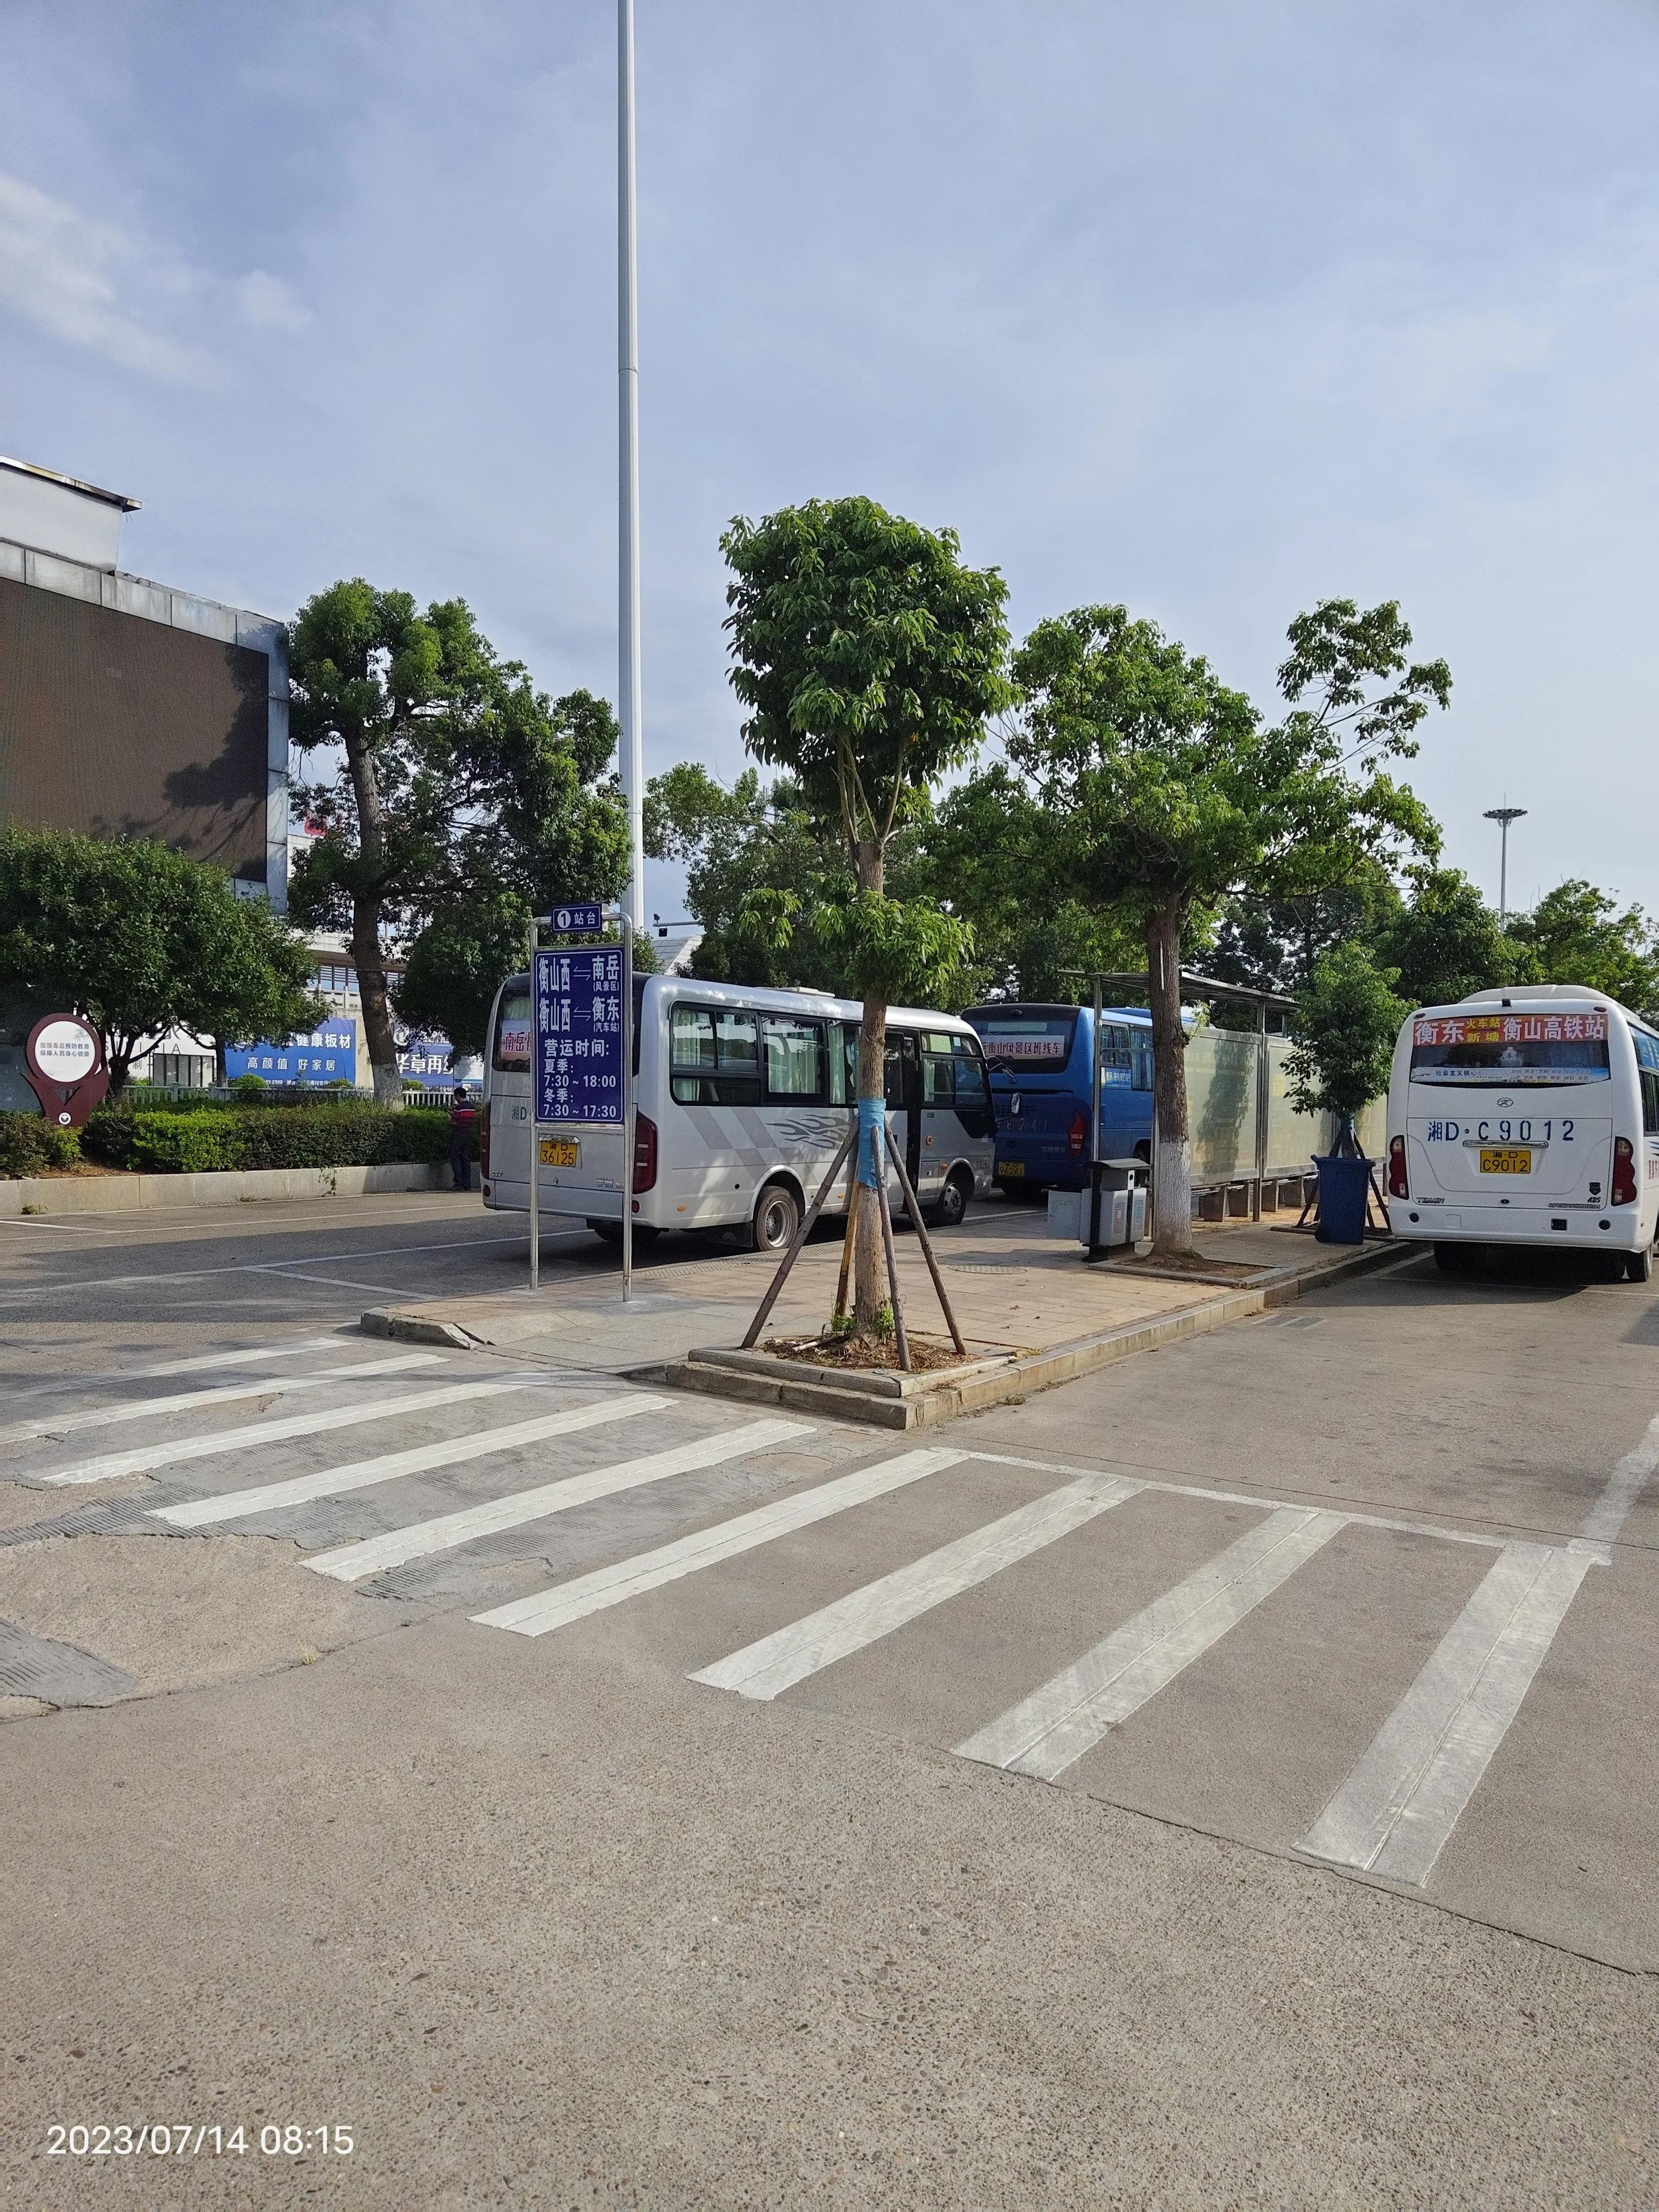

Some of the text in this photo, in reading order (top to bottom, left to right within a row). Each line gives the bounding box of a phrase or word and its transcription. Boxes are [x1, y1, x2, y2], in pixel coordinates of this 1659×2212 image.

[574, 911, 595, 925] 站台
[539, 954, 619, 993] 衡山西 南岳
[594, 981, 619, 992] (风景区)
[539, 996, 619, 1033] 衡山西 衡东
[594, 1022, 619, 1033] (汽车站)
[1415, 1016, 1605, 1045] 衡东 火车站 衡山高铁站
[1467, 1032, 1499, 1043] 新塘
[544, 1038, 609, 1057] 营运时间:
[247, 1057, 336, 1071] 高颜值 好家居
[544, 1058, 574, 1073] 夏季:
[543, 1075, 569, 1087] 7:30
[583, 1075, 616, 1088] 18:00
[544, 1088, 574, 1103] 冬季:
[543, 1104, 569, 1116] 7:30
[583, 1105, 617, 1118] 17:30
[542, 1150, 574, 1165] 36125
[1483, 1159, 1528, 1172] C9012
